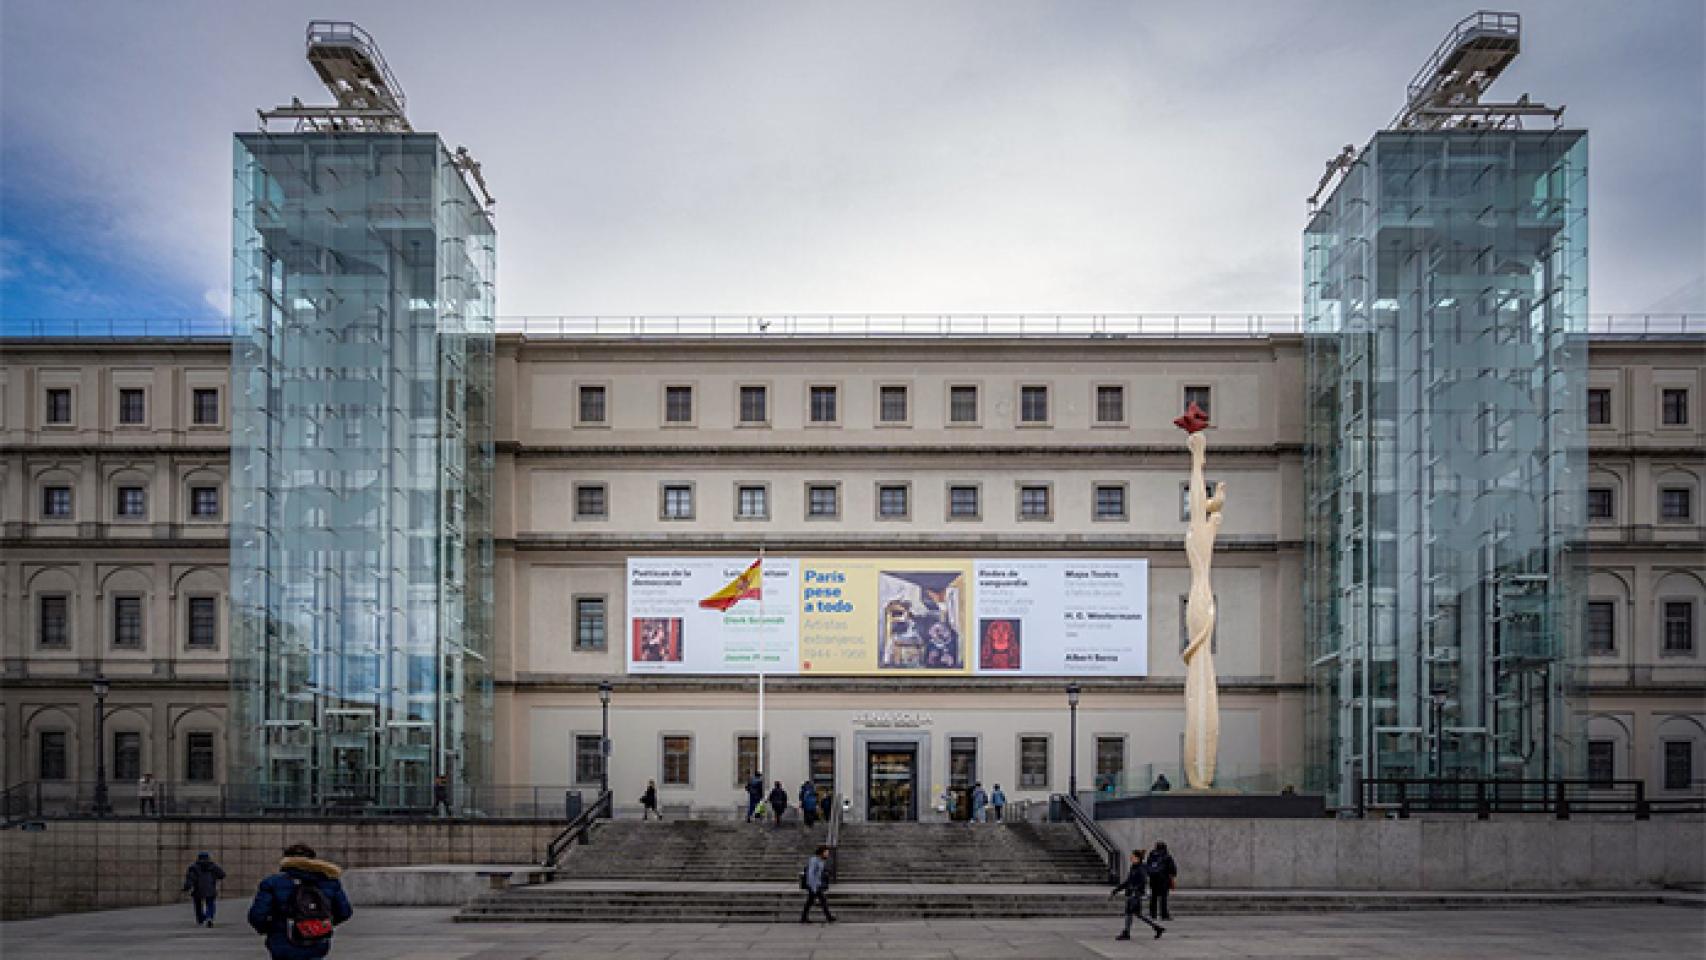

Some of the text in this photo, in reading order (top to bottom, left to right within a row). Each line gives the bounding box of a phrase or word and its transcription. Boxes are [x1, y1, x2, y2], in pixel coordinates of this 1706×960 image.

[804, 588, 841, 600] pese
[804, 600, 854, 612] a todo
